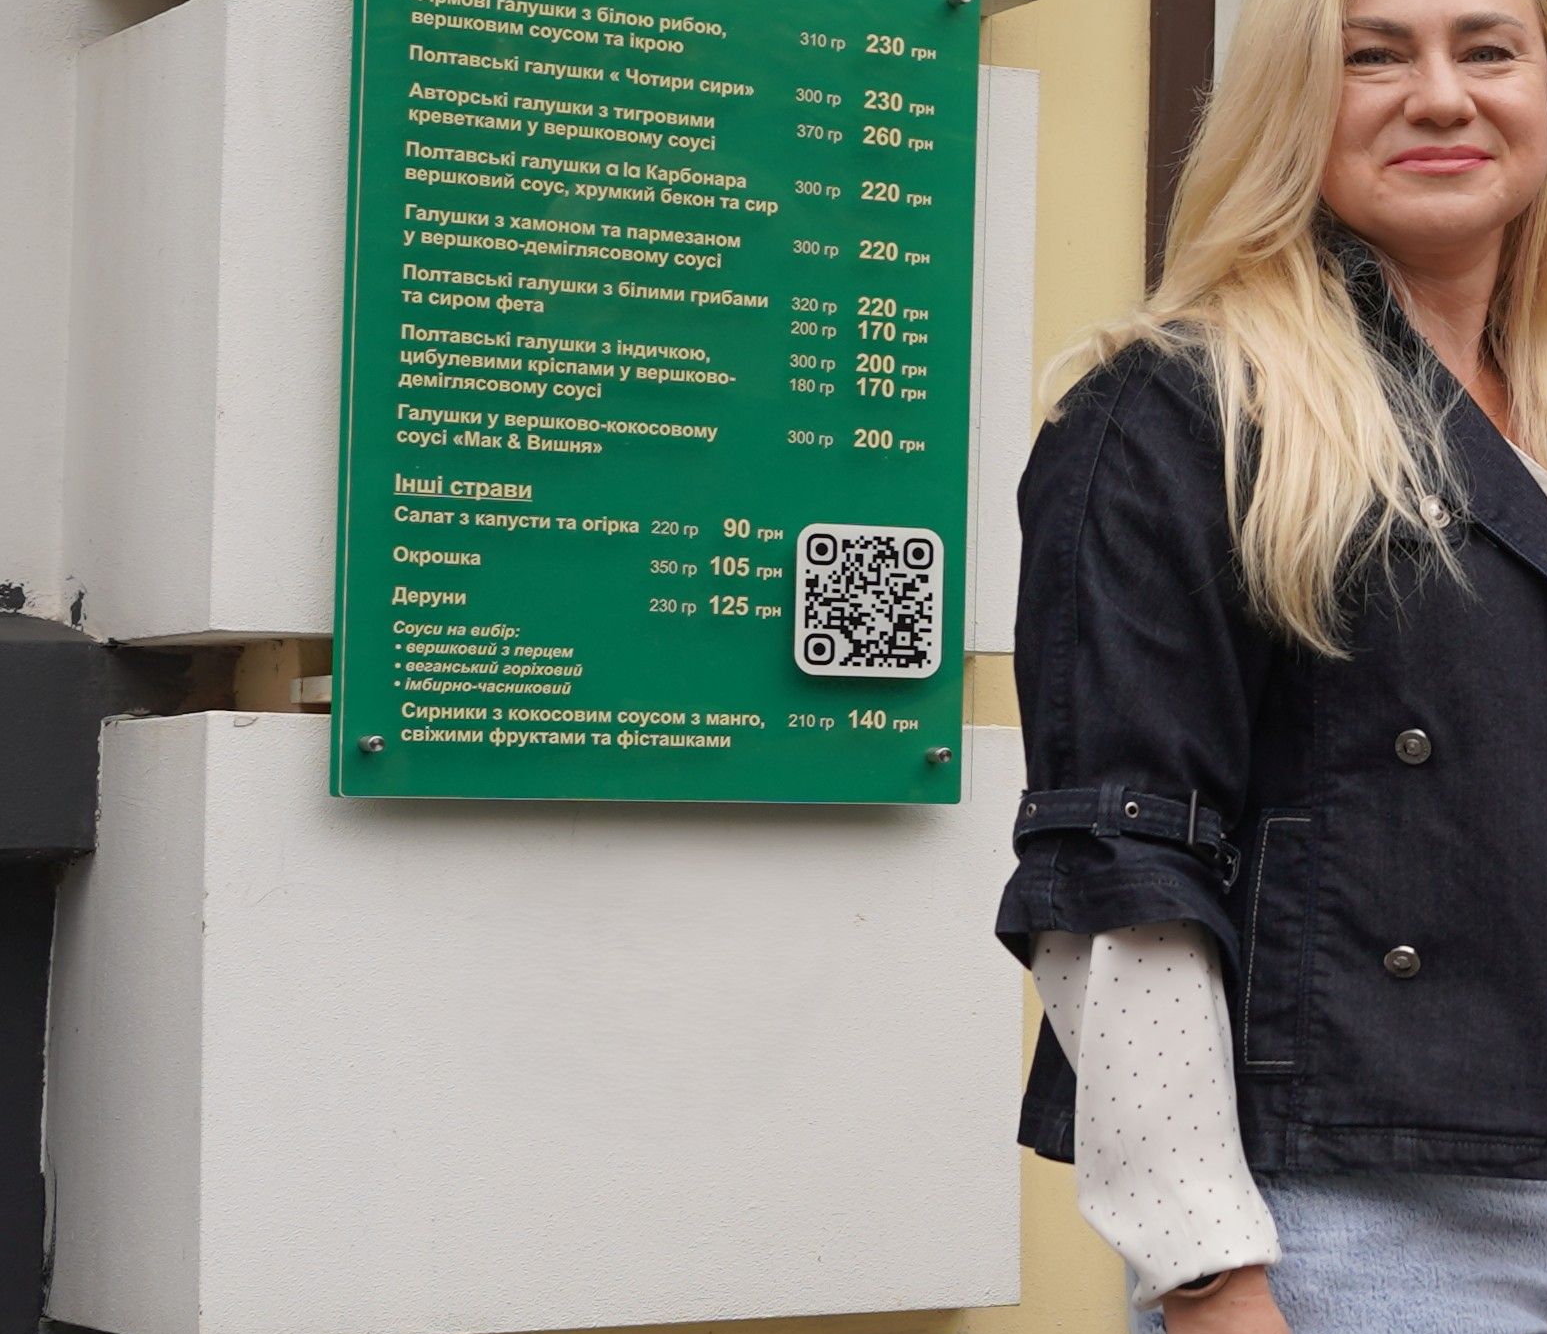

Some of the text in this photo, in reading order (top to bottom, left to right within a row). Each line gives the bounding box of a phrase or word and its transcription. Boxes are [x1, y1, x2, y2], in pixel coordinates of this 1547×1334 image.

[412, 12, 684, 53] вершковим соусом та ікрою
[497, 0, 576, 19] галушки
[582, 8, 591, 20] з
[597, 7, 654, 27] білою
[660, 17, 726, 38] рибою,
[800, 32, 936, 61] 310 гр 230 грн
[410, 45, 518, 71] Полтавські
[525, 61, 604, 80] галушки
[626, 68, 694, 91] Чотири
[700, 80, 754, 97] сири»
[409, 83, 714, 128] Авторські галушки з тигровими
[409, 109, 715, 152] креветками у вершковому соусі
[797, 124, 933, 151] 370 гр 260 грн
[406, 141, 515, 166] Полтавські
[521, 156, 600, 175] галушки
[646, 164, 746, 190] Карбонара
[405, 168, 778, 216] вершковий соус, хрумкий бекон та сир
[796, 181, 931, 207] 300 гр 220 грн
[406, 204, 740, 247] Галушки з хамоном та пармезаном
[404, 230, 721, 270] у вершково-деміглясовому соусі
[403, 264, 768, 307] Полтавські галушки з білими грибами
[402, 291, 544, 313] та сиром фета
[792, 297, 928, 321] 320 гр 220 грн
[401, 324, 710, 363] Полтавські галушки з індичкою,
[401, 349, 736, 384] цибулевими кріспами у вершково-
[790, 353, 927, 378] 300 гр 200 грн
[398, 372, 601, 401] деміглясовому соусі
[790, 377, 926, 401] 180 гр 170 грн
[398, 404, 717, 442] Галушки у вершково-кокосовому
[397, 430, 602, 453] соусі «Мак & Вишня»
[394, 474, 532, 499] Інші страви
[395, 506, 783, 541] Салат з капусти та огірка 220 гр 90 грн
[393, 546, 480, 566] Окрошка
[651, 556, 782, 580] 350 гр 105 грн
[392, 587, 466, 607] Деруни
[650, 595, 781, 619] 230 гр 125 грн
[393, 621, 519, 640] Соуси на вибір:
[406, 643, 573, 659] вершковий з перцем
[406, 662, 582, 677] веганський горіховий
[405, 678, 571, 694] імбирно-часниковий
[402, 702, 918, 732] Сирники з кокосовим соусом з манго, 210 гр 140 грн
[401, 726, 730, 749] свіжими фруктами та фісташками
